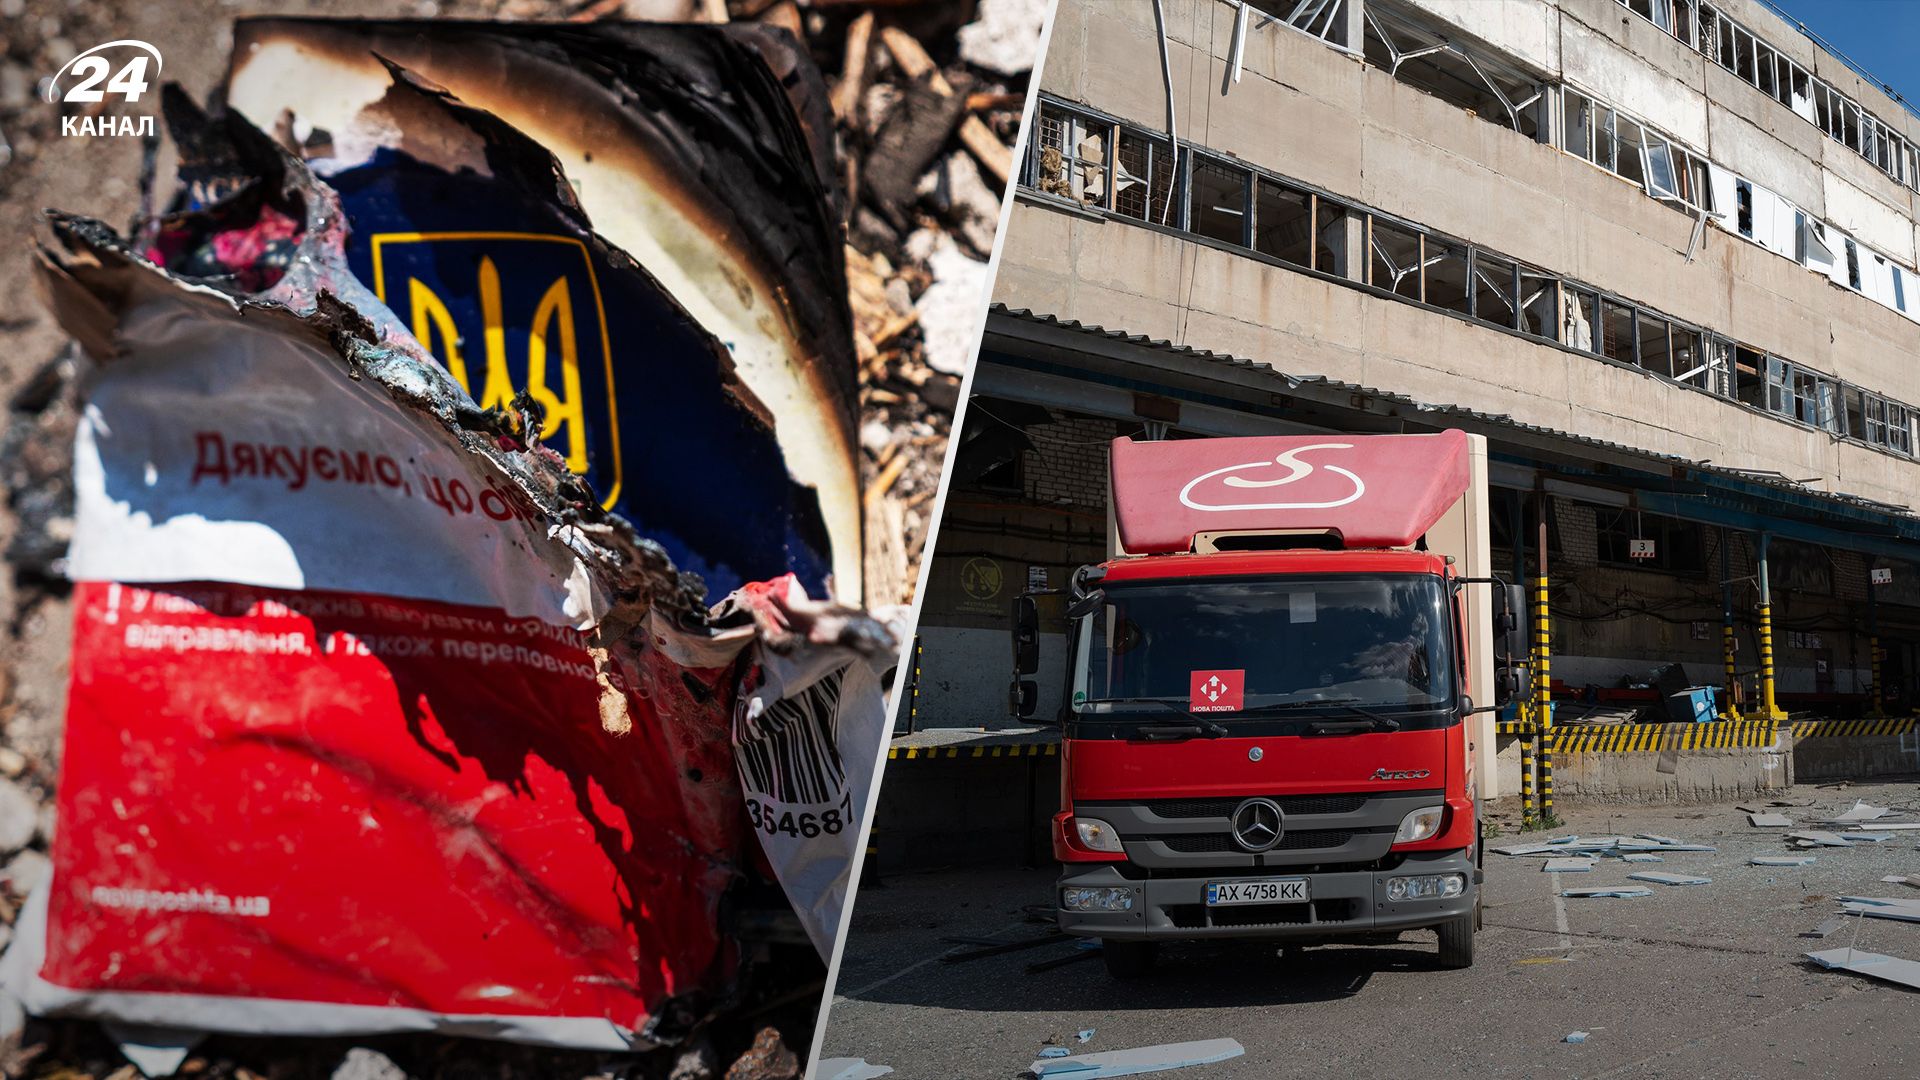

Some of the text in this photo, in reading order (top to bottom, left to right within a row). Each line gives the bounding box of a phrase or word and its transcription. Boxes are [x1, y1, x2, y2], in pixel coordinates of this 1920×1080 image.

[191, 431, 411, 495] Дякуємо,
[1639, 542, 1646, 551] 3
[1243, 884, 1278, 900] 4758
